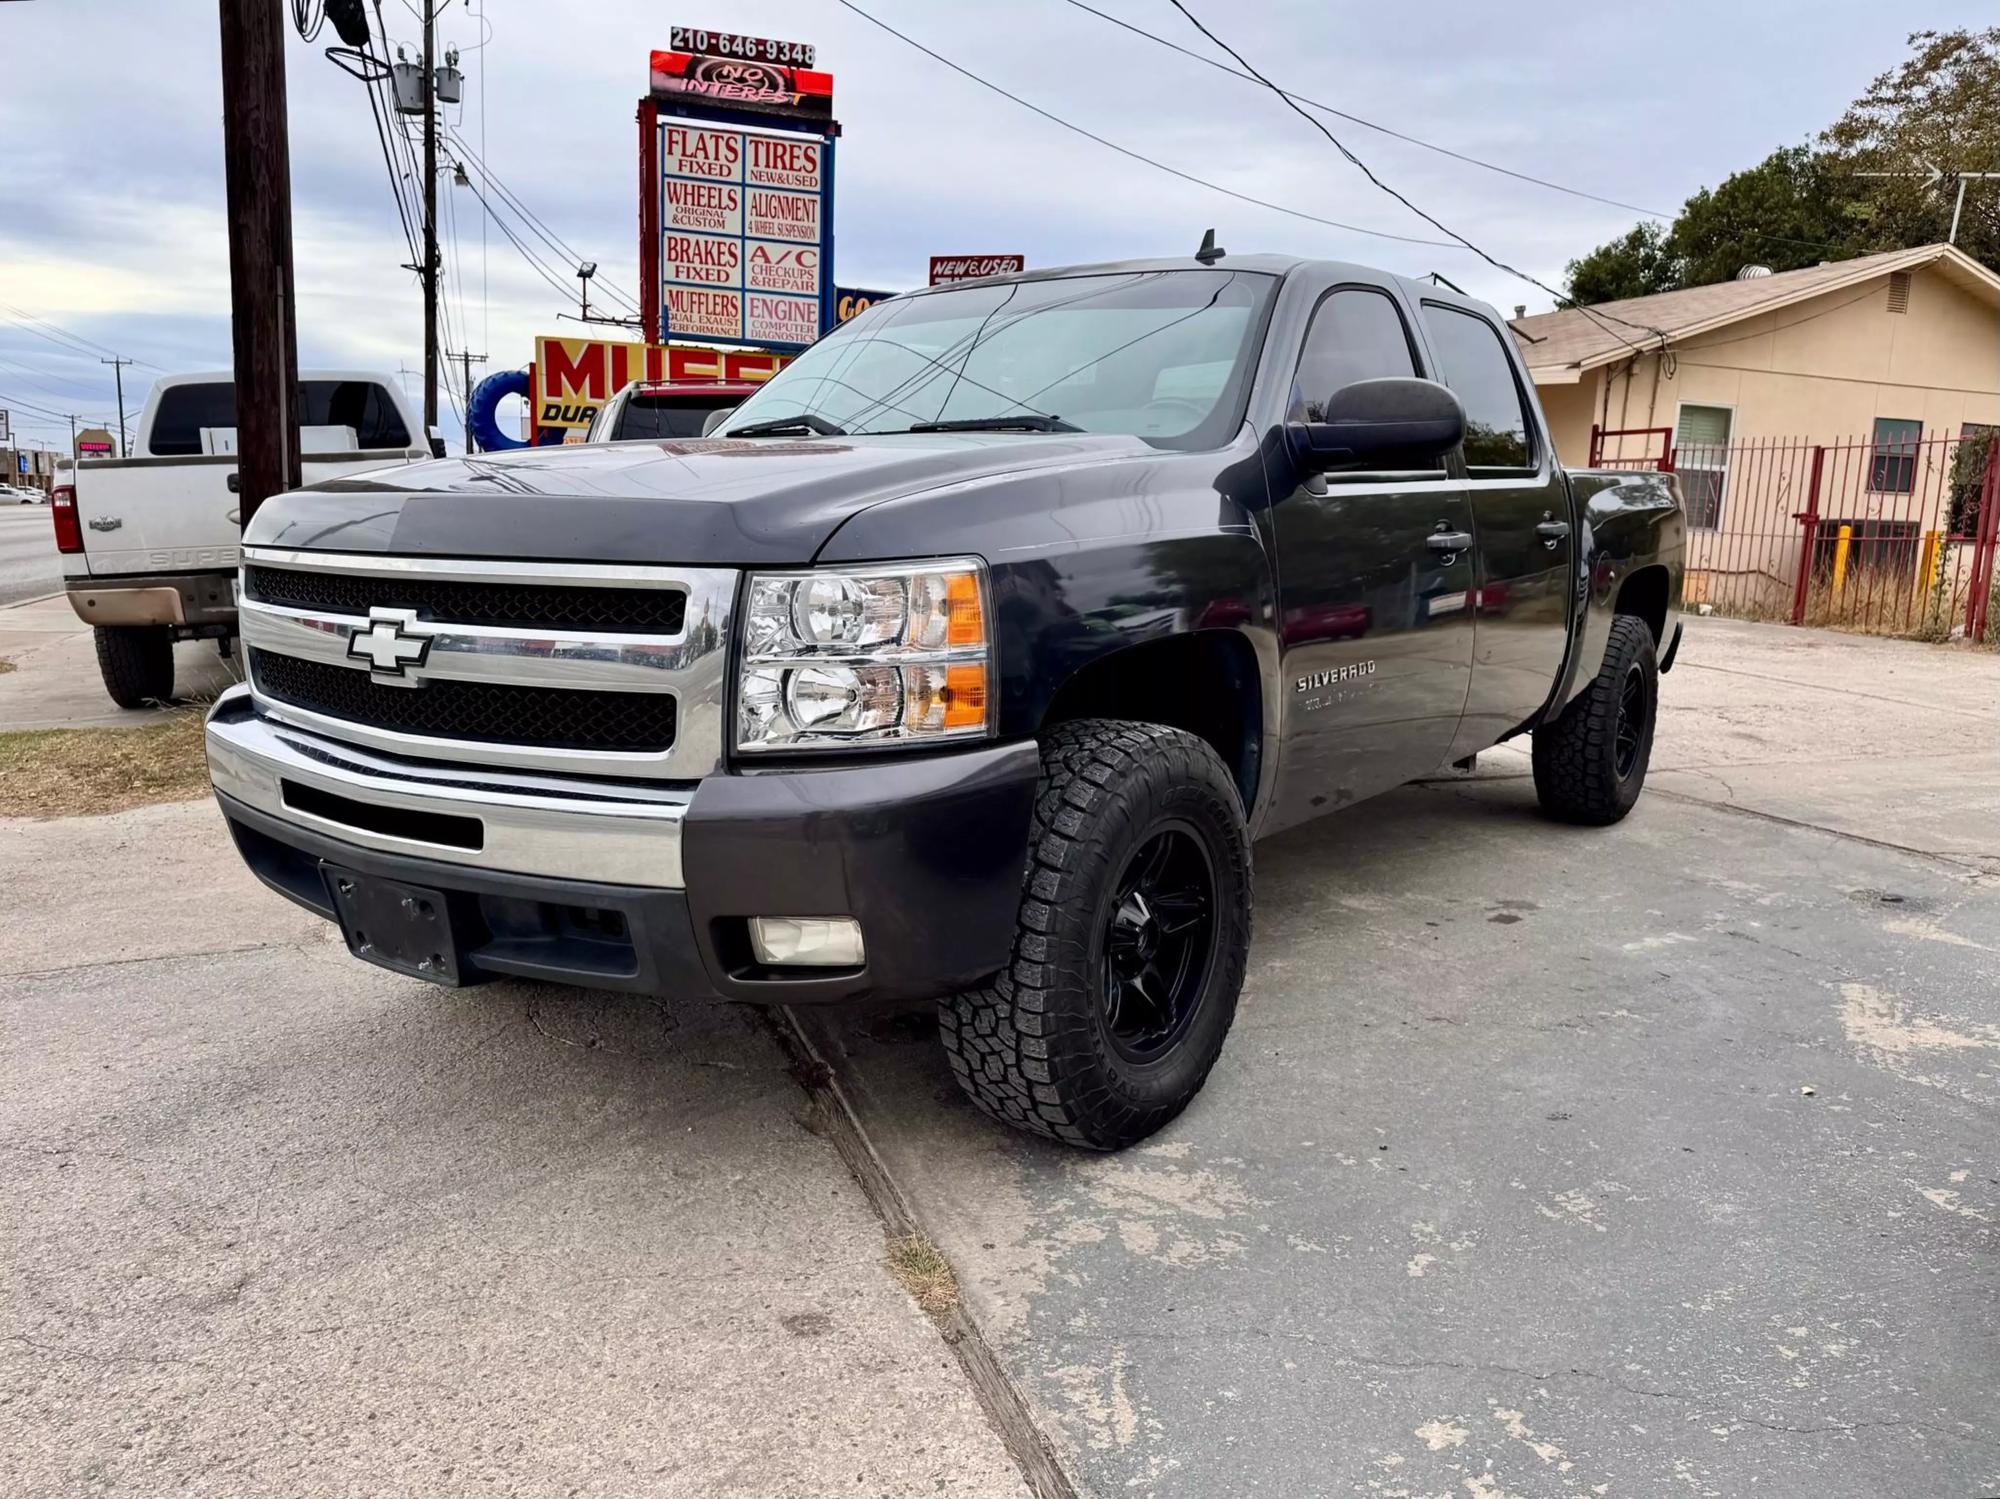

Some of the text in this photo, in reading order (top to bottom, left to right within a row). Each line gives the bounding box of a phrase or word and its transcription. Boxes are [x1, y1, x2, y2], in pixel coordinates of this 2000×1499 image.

[672, 27, 816, 65] 210-646-9348
[721, 64, 764, 80] NO
[680, 78, 806, 106] INTEREST
[667, 128, 739, 163] FLATS
[749, 139, 817, 174] TIRES
[678, 158, 732, 178] FIXED
[750, 169, 818, 188] NEW&USED
[666, 181, 738, 212] WHEELS
[675, 206, 727, 219] ORIGINAL
[750, 192, 818, 223] ALIGNMENT
[672, 214, 726, 230] &CUSTOM
[748, 220, 817, 240] 4 WHEEL SUSPENSION
[667, 236, 739, 269] BRAKES
[749, 245, 817, 269] A/C
[675, 265, 730, 283] FIXED
[751, 263, 815, 281] CHECKUPS
[750, 275, 816, 292] &REPAIR
[668, 289, 739, 318] MUFFLERS
[750, 297, 817, 324] ENGINE
[699, 315, 740, 328] EXAUST
[751, 319, 815, 334] COMPUTER
[751, 329, 816, 343] DIAGNOSTICS
[1297, 660, 1376, 693] SILVERADO
